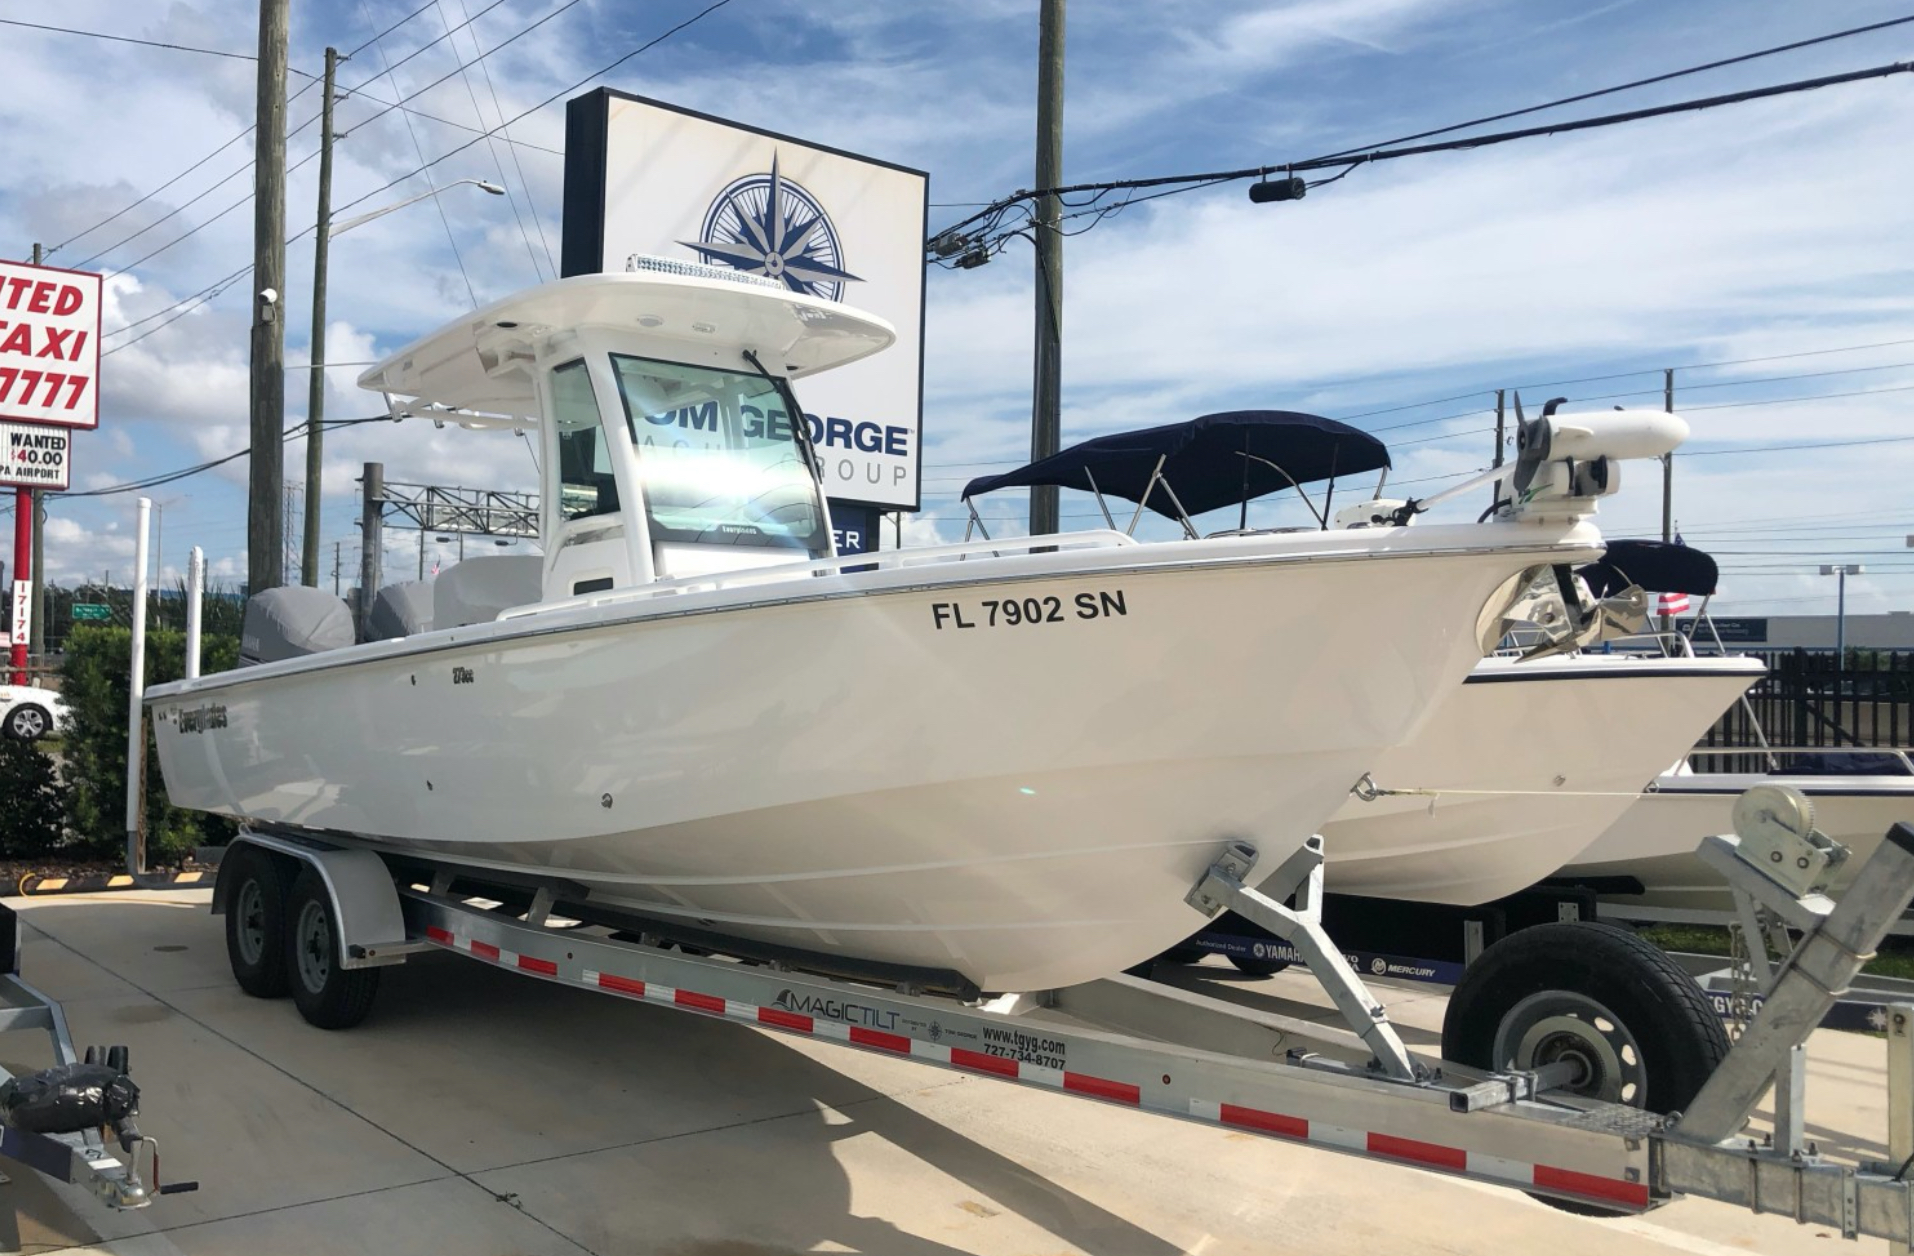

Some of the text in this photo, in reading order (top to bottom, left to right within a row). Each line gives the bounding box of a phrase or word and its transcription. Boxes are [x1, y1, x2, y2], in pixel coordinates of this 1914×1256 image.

[0, 275, 84, 317] TED
[11, 432, 67, 450] WANTED
[11, 449, 63, 466] $40.00
[16, 466, 60, 480] AIRPORT
[932, 590, 1128, 630] FL 7902 SN
[1227, 943, 1247, 953] Dealer
[1266, 944, 1304, 962] YAMAH
[1387, 964, 1436, 977] MERCURY
[982, 1026, 1066, 1055] www.tgyg.com
[983, 1043, 1067, 1070] 727-734-8707
